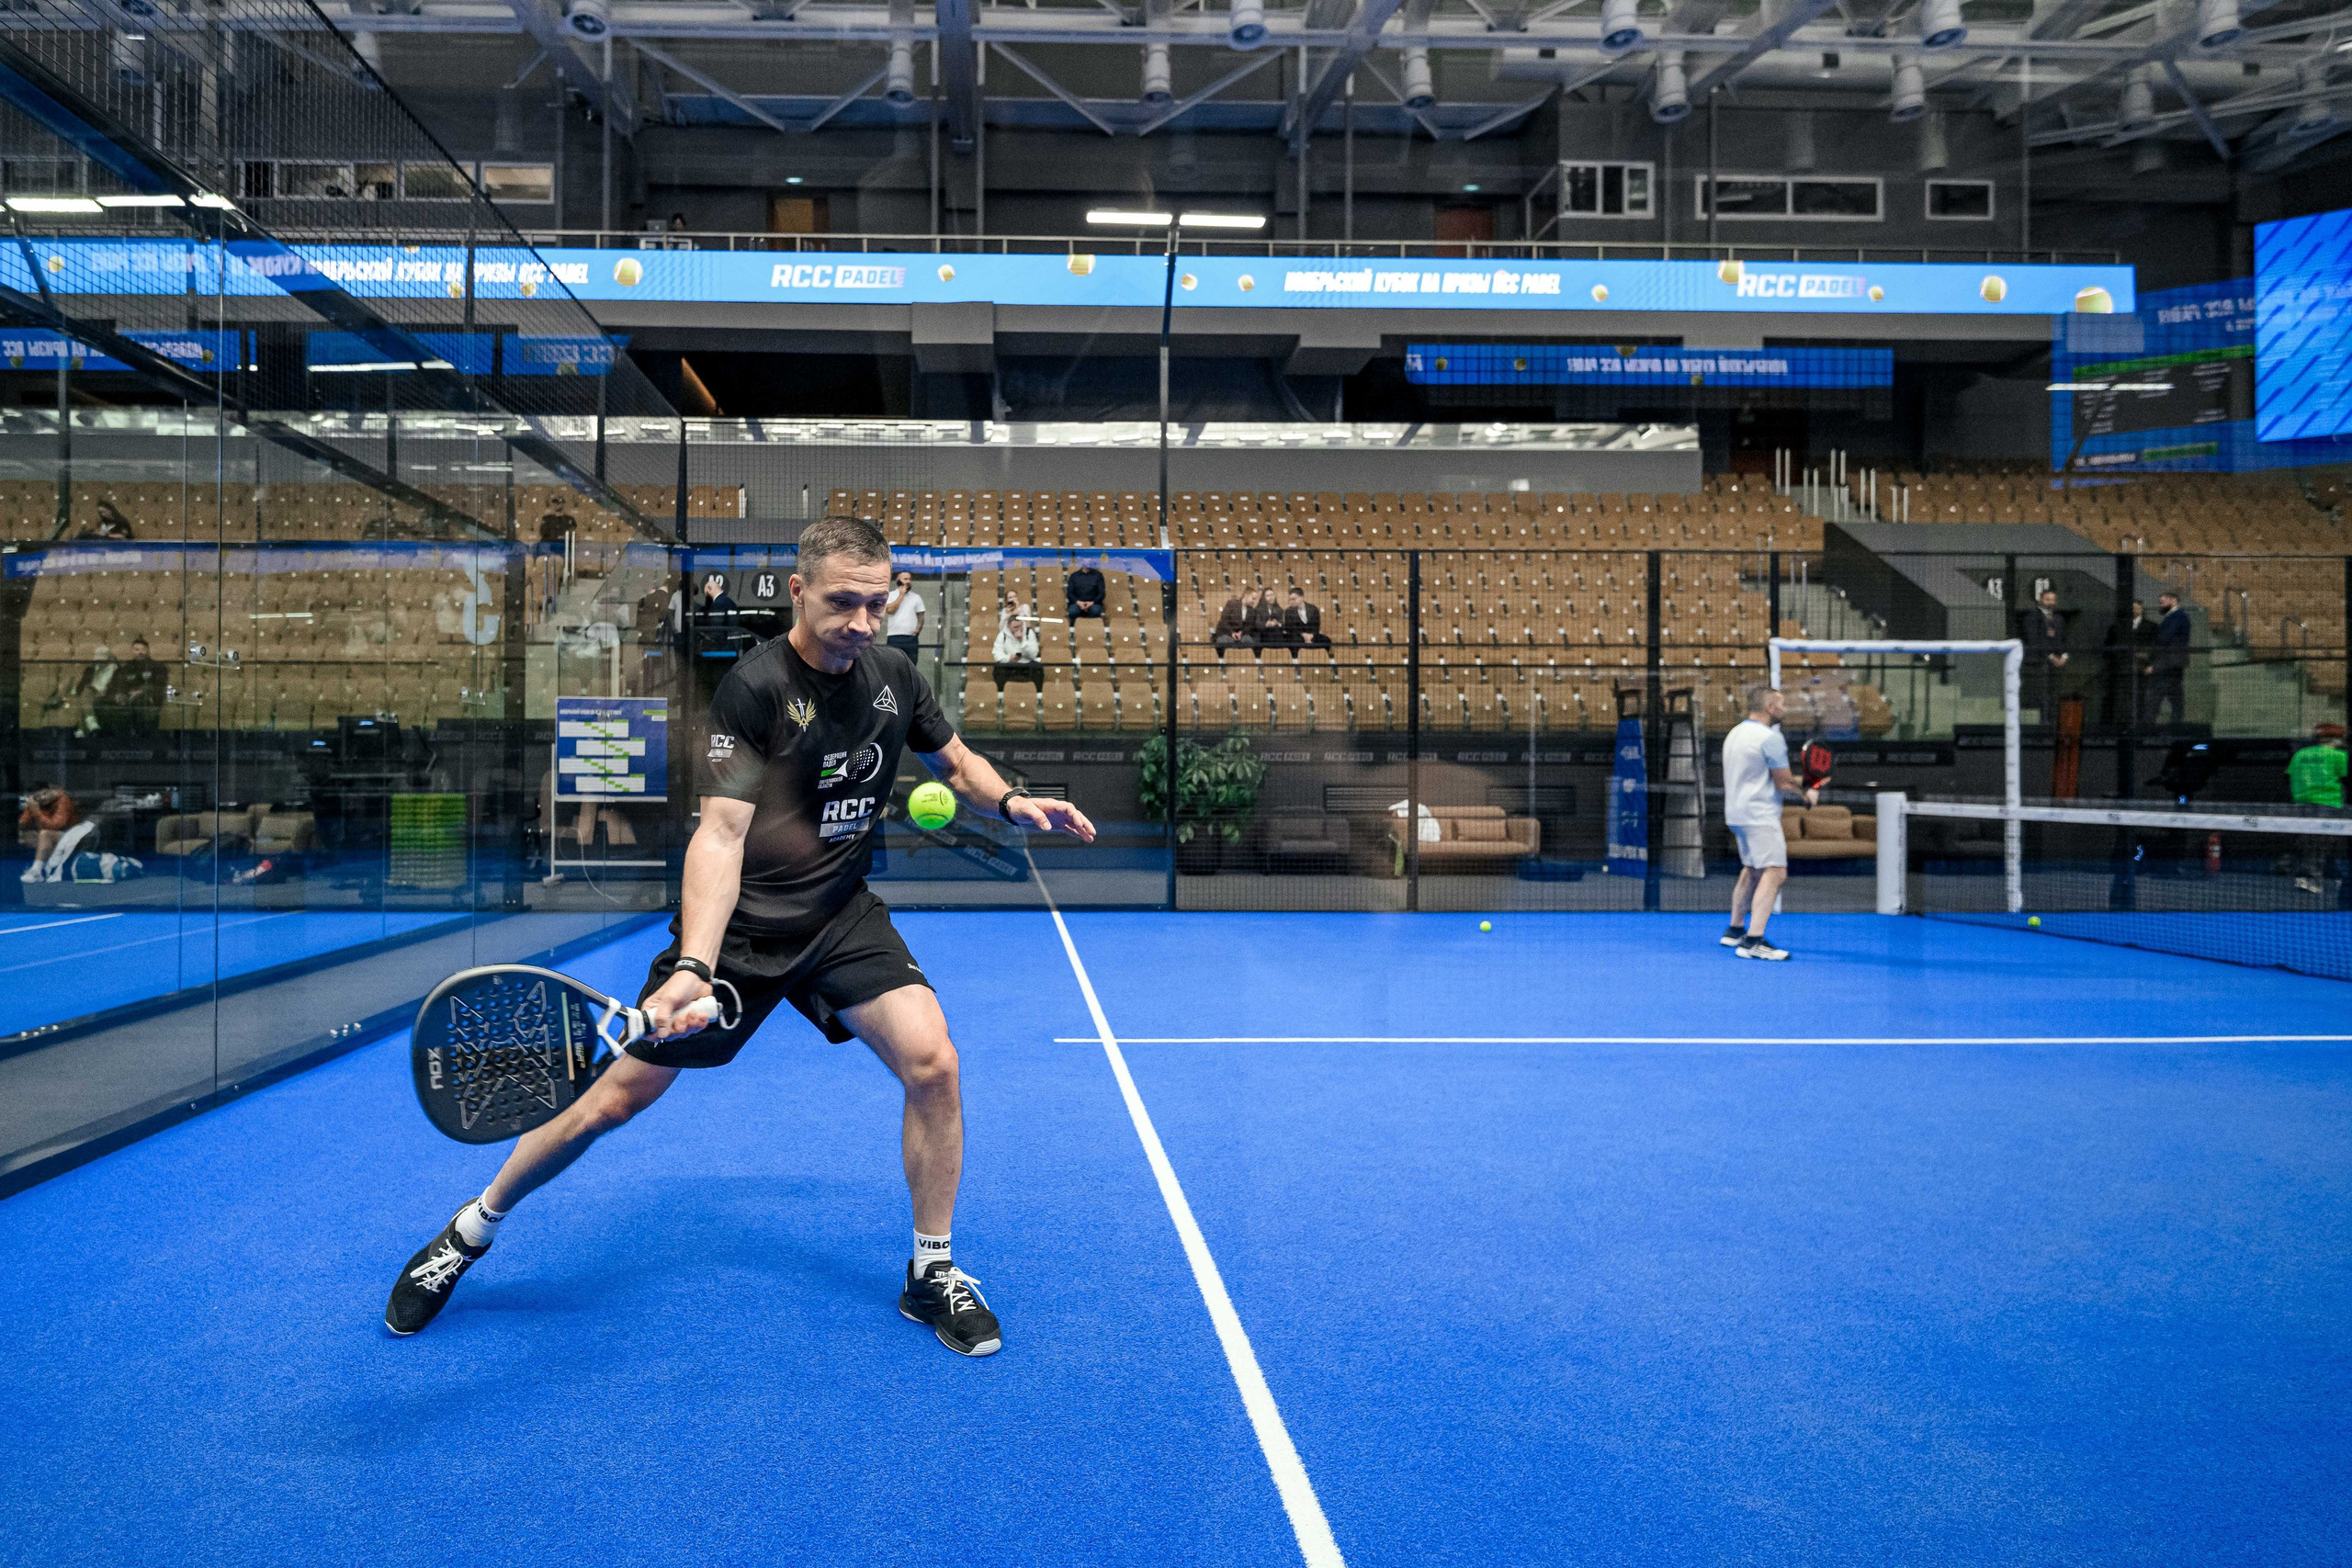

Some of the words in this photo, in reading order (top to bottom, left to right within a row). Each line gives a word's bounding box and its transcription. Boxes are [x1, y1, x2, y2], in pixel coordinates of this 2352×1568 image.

[473, 262, 516, 283] РИЗЫ
[771, 265, 833, 288] RCC
[840, 268, 899, 286] PADEL
[1736, 274, 1797, 298] RCC
[1804, 278, 1860, 295] PADEL
[757, 574, 775, 597] A3
[822, 796, 876, 822] RCC
[829, 834, 855, 843] ACADEMY
[832, 823, 857, 833] PADEL
